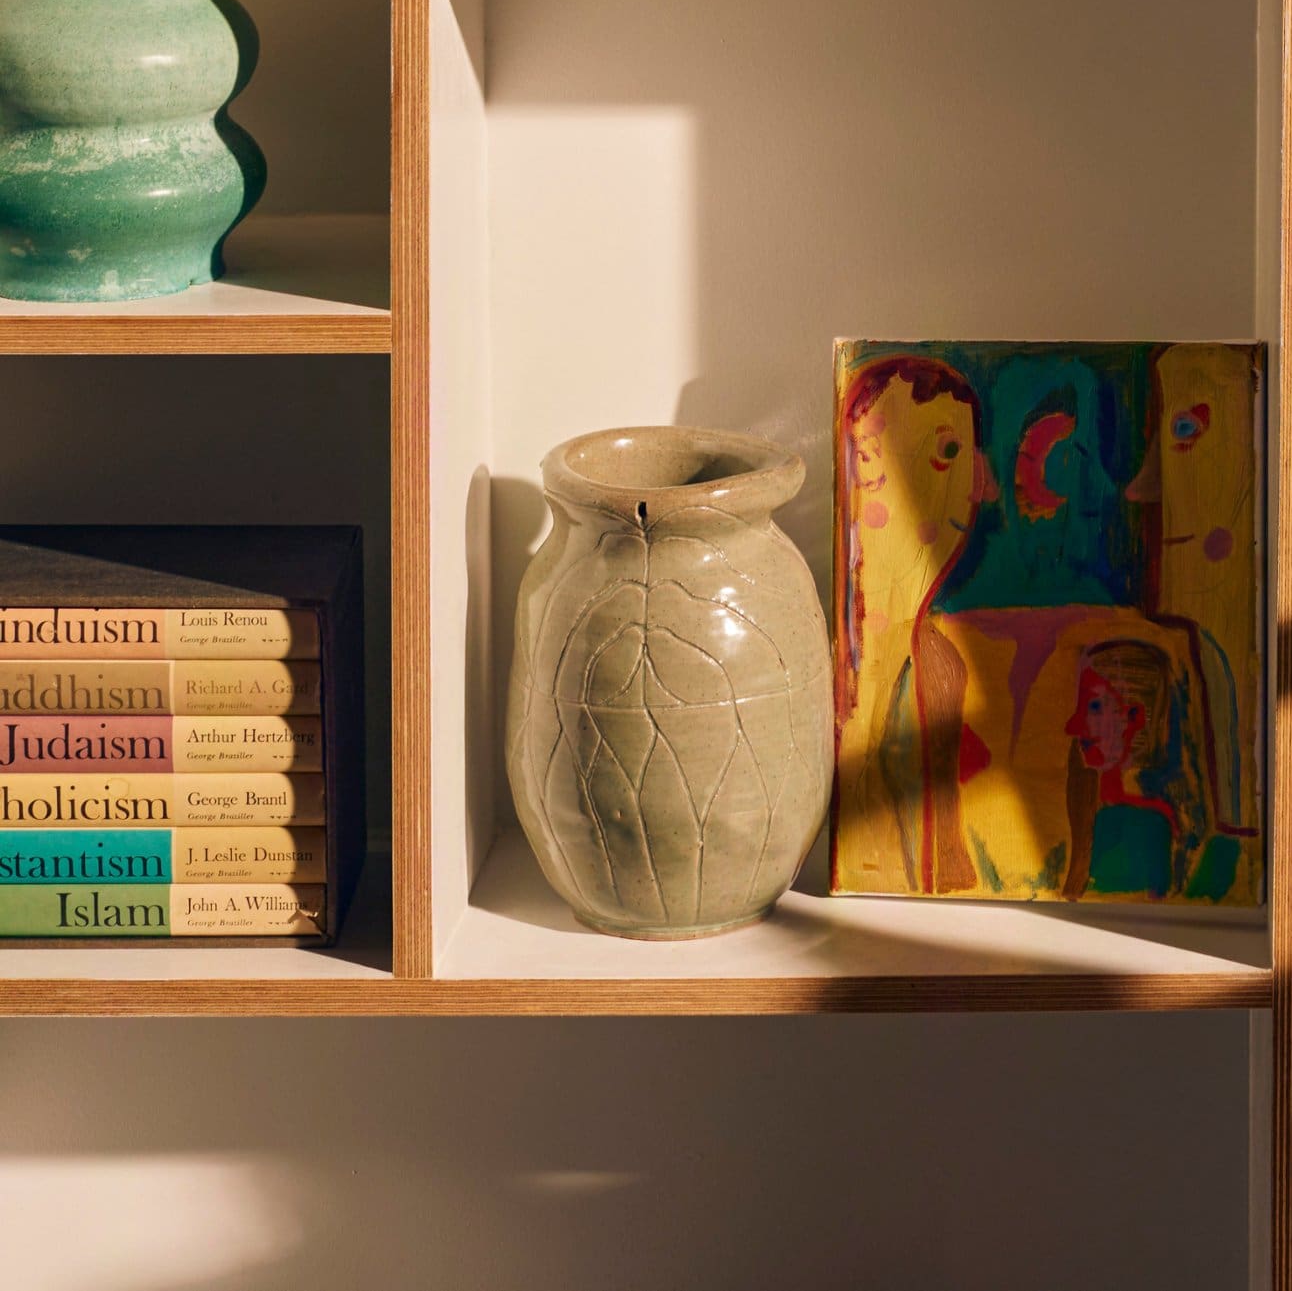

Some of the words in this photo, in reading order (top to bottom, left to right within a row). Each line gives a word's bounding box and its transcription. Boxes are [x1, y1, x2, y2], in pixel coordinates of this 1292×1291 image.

[180, 611, 218, 627] Louis
[223, 612, 268, 627] Renou
[180, 636, 208, 645] George
[212, 635, 247, 644] Braziller
[0, 723, 168, 767] Judaism
[186, 729, 235, 744] Arthur
[243, 729, 315, 746] Hertzberg
[187, 791, 238, 808] George
[245, 791, 288, 806] Brantl
[186, 848, 198, 866] J.
[204, 847, 247, 863] Leslie
[254, 848, 313, 863] Dunstan
[56, 892, 168, 928] Islam
[186, 897, 218, 915] John
[225, 897, 241, 912] A.
[245, 896, 308, 912] Williams
